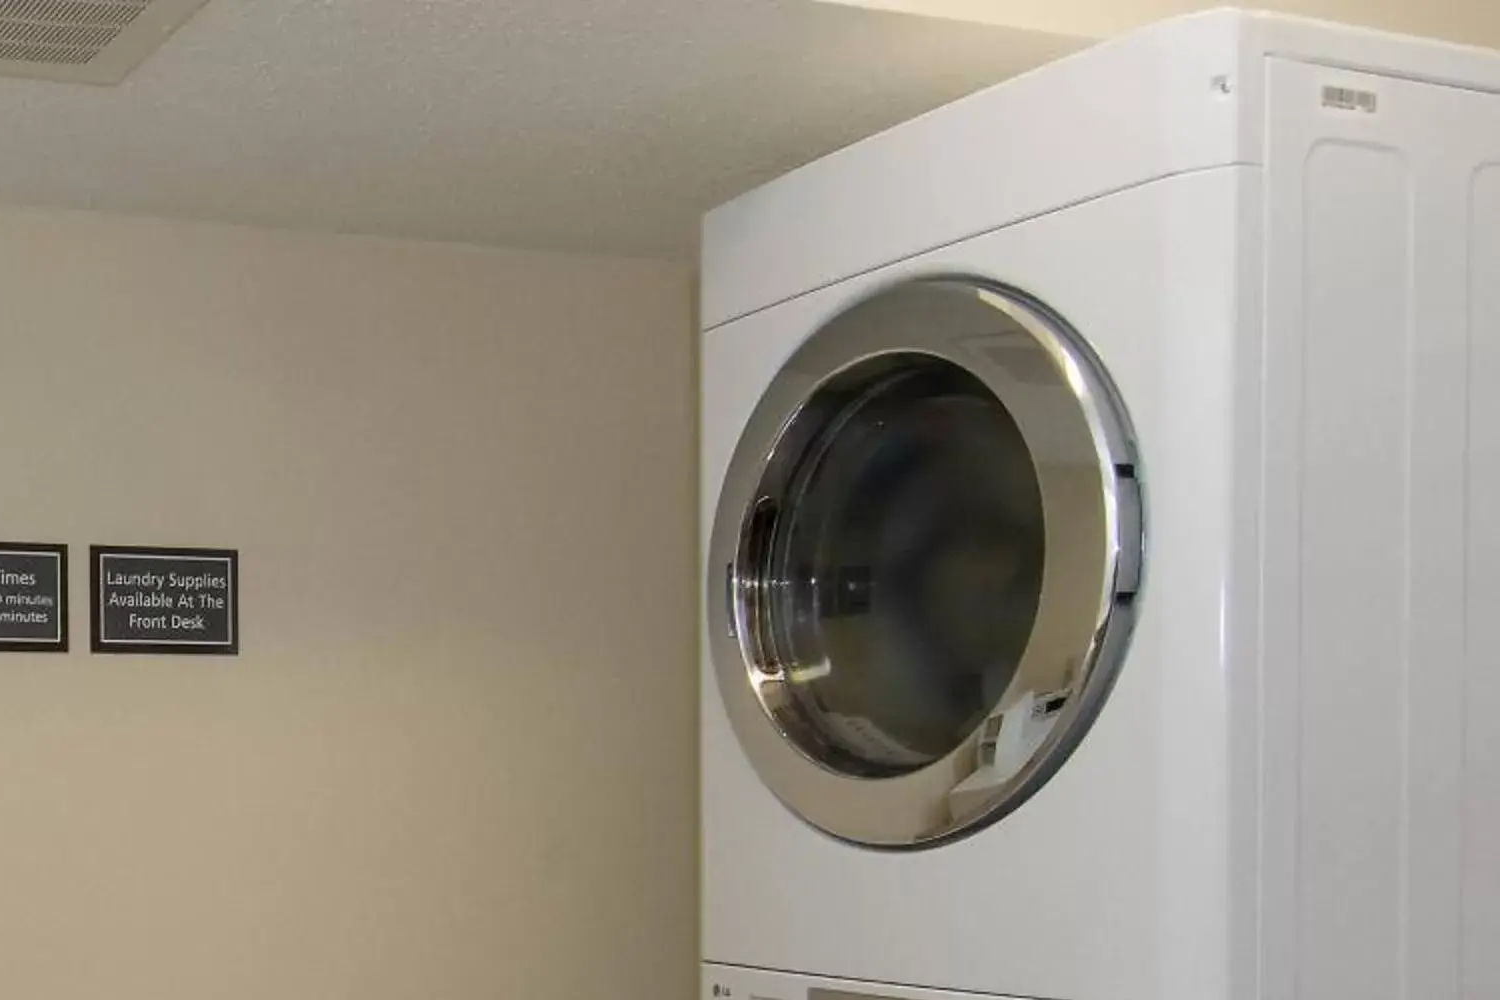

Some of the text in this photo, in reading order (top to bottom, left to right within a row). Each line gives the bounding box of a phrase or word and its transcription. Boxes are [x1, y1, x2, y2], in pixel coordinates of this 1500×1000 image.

[107, 569, 227, 591] Laundry Supplies
[5, 593, 54, 606] minutes
[109, 591, 225, 609] Available At The
[0, 610, 49, 623] minutes
[129, 613, 206, 629] Front Desk
